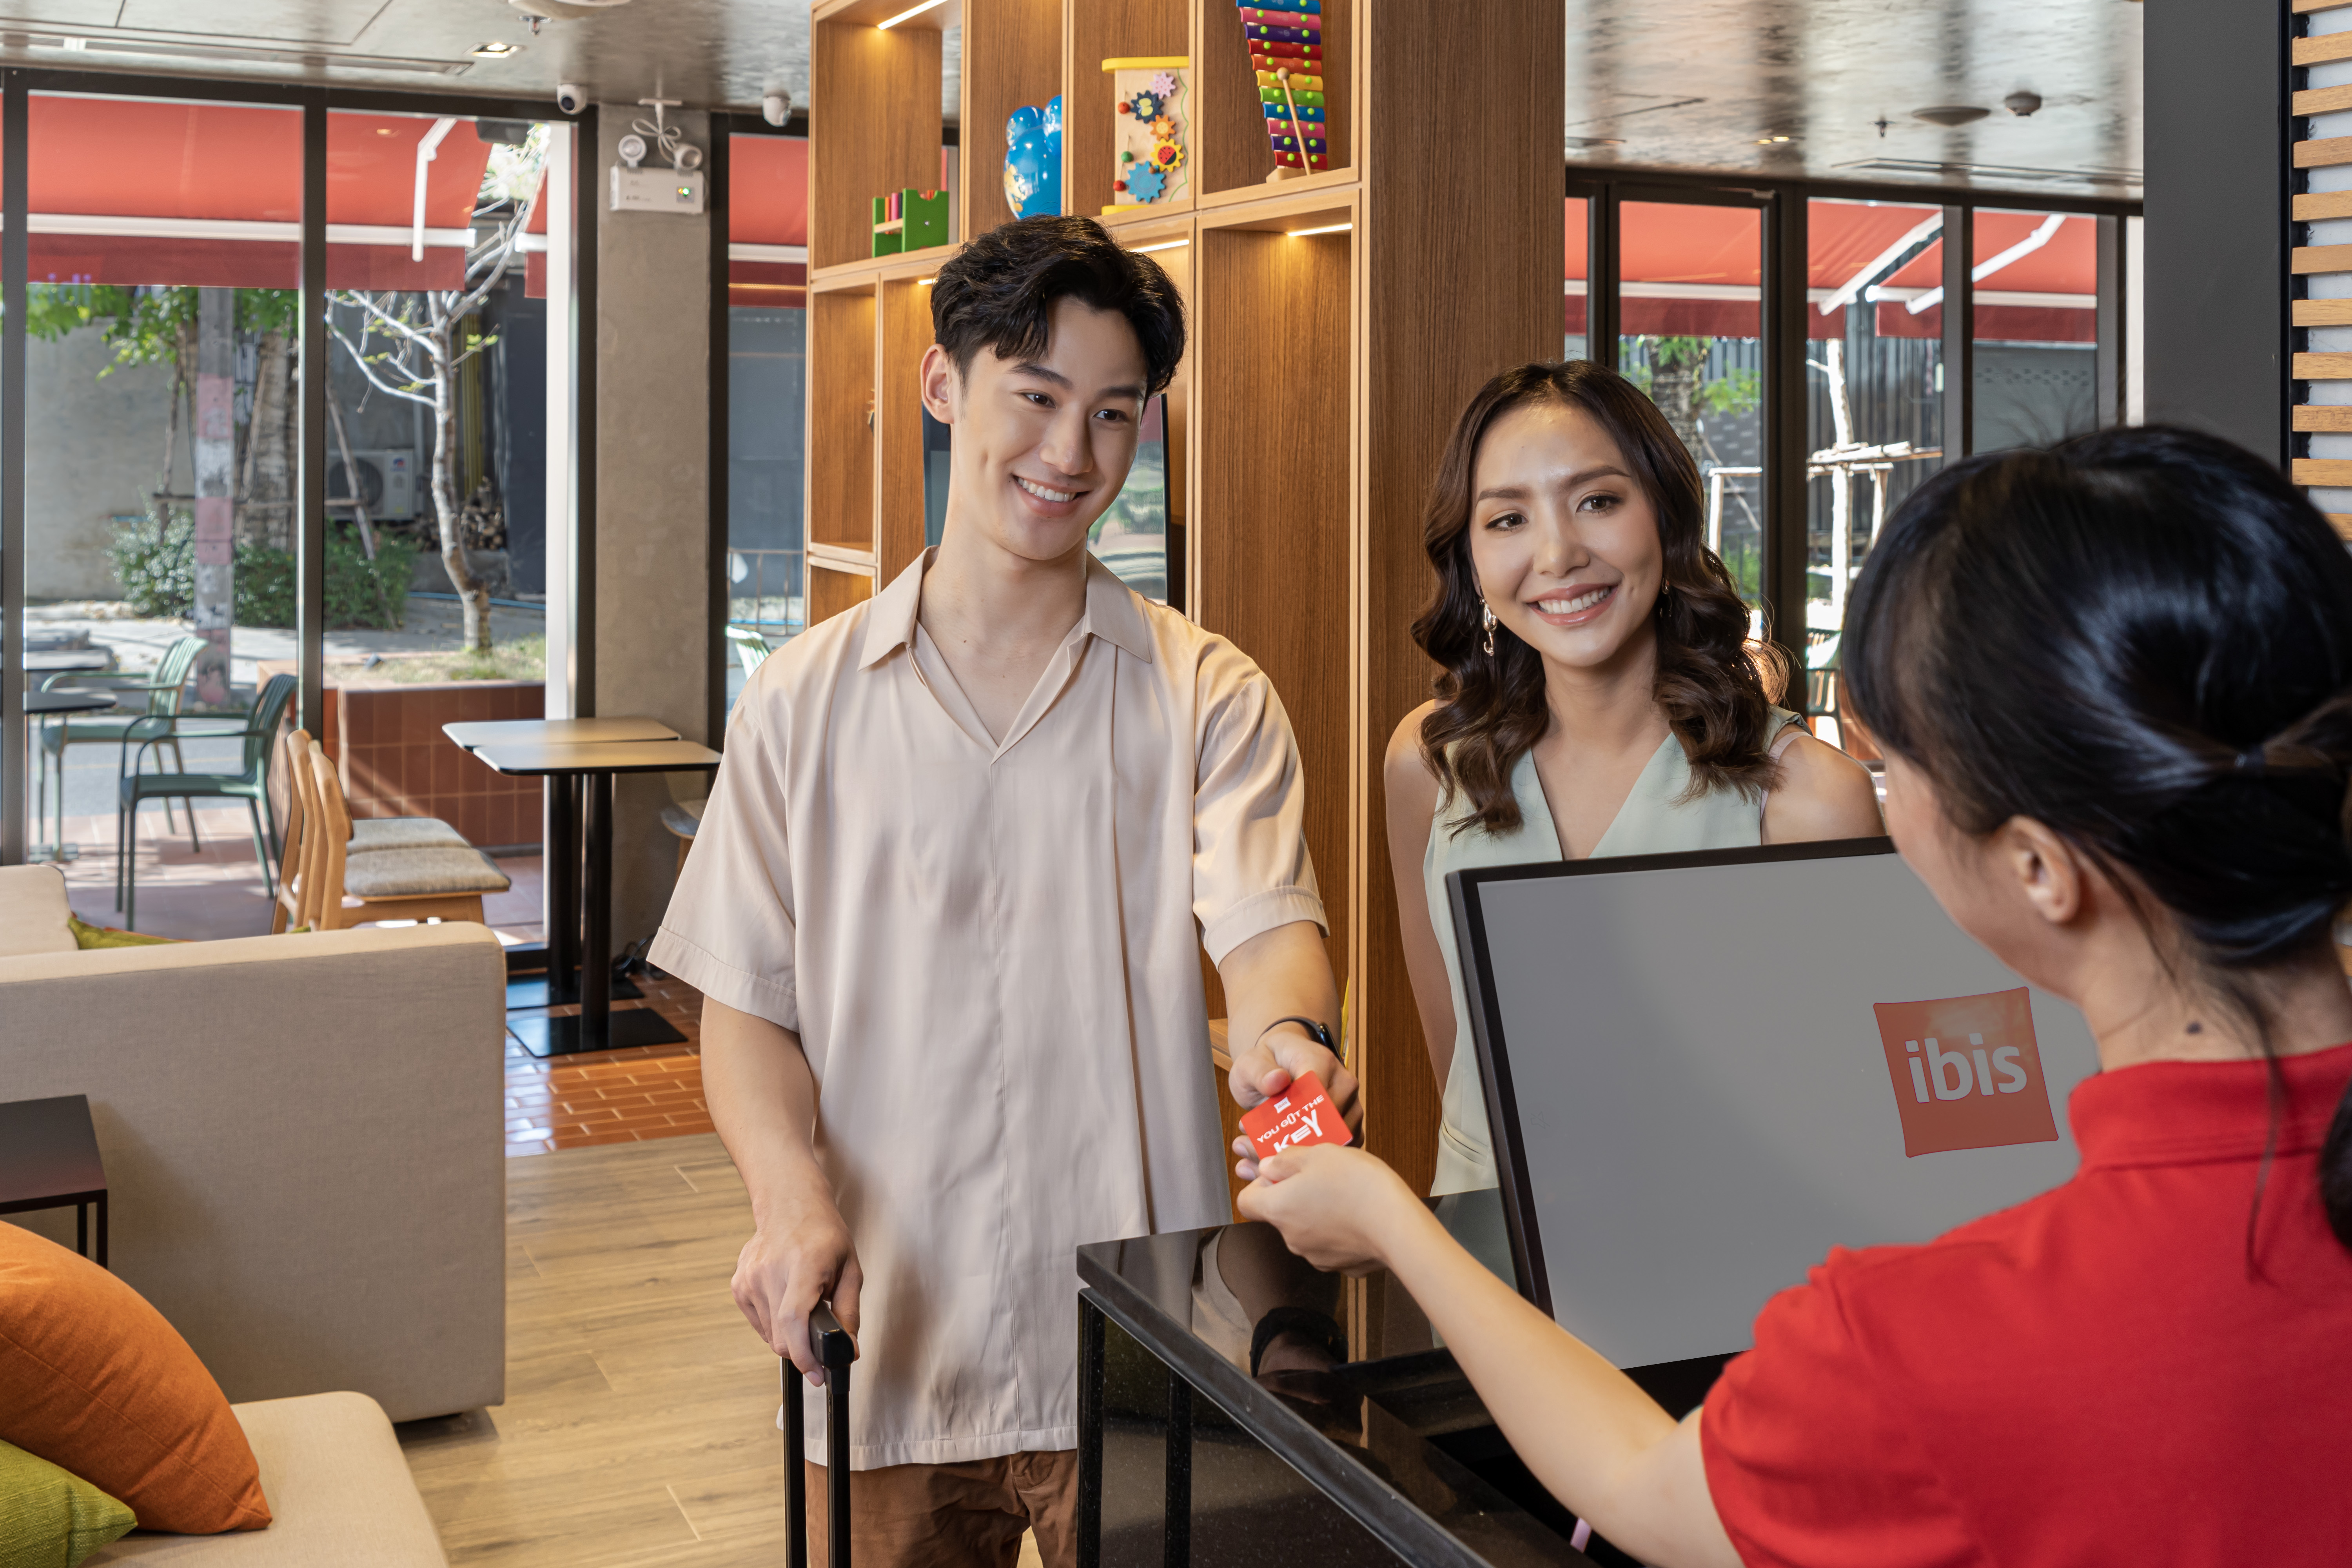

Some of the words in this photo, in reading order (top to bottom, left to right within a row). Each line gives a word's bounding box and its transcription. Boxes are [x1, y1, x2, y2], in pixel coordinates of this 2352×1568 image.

[1905, 1033, 2027, 1103] ibis
[1256, 1125, 1279, 1143] YOU
[1280, 1109, 1301, 1127] GOT
[1301, 1094, 1324, 1111] THE
[1273, 1109, 1323, 1153] KEY
